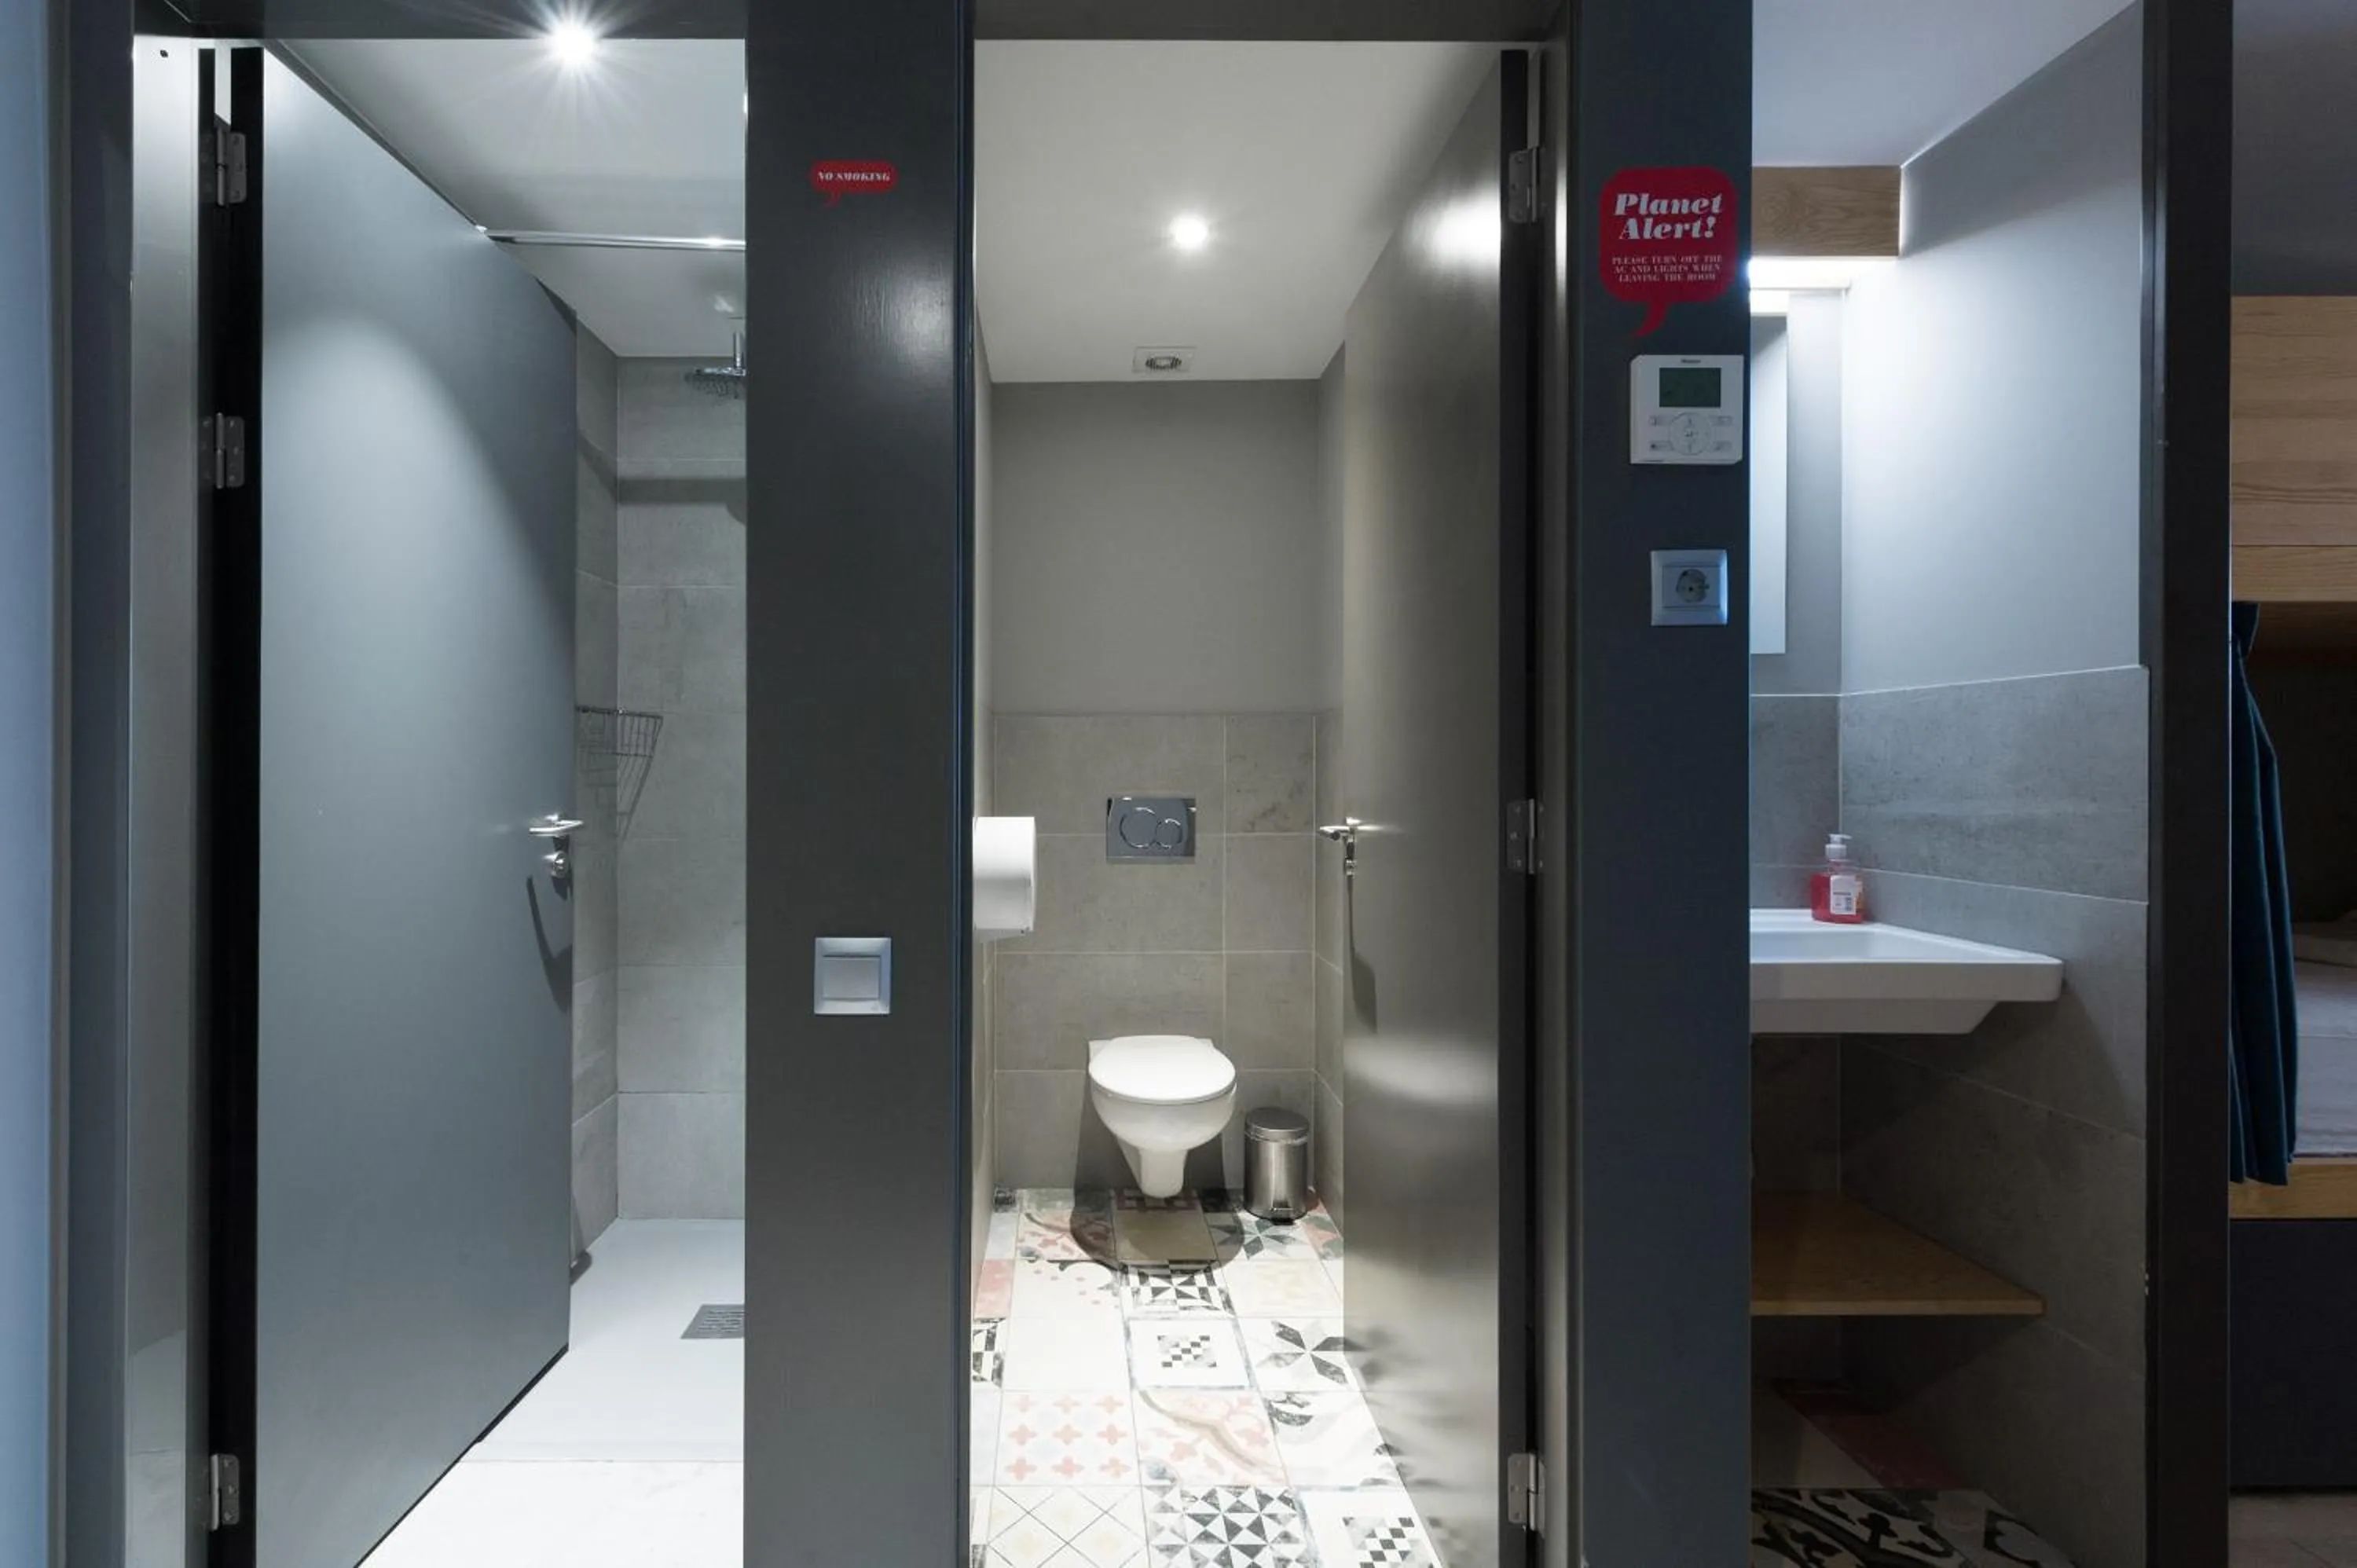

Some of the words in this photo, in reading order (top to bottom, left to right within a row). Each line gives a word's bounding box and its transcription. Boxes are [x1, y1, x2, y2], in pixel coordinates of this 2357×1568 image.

[818, 171, 833, 181] NO
[1614, 192, 1723, 216] Planet
[1618, 216, 1716, 240] Alert!
[1612, 256, 1647, 265] PLEASE
[1651, 255, 1677, 264] TURN
[1703, 255, 1722, 263] THE
[1631, 265, 1651, 273] AND
[1692, 263, 1720, 272] WHEN
[1619, 274, 1659, 283] LEAVING
[1665, 273, 1681, 282] THE
